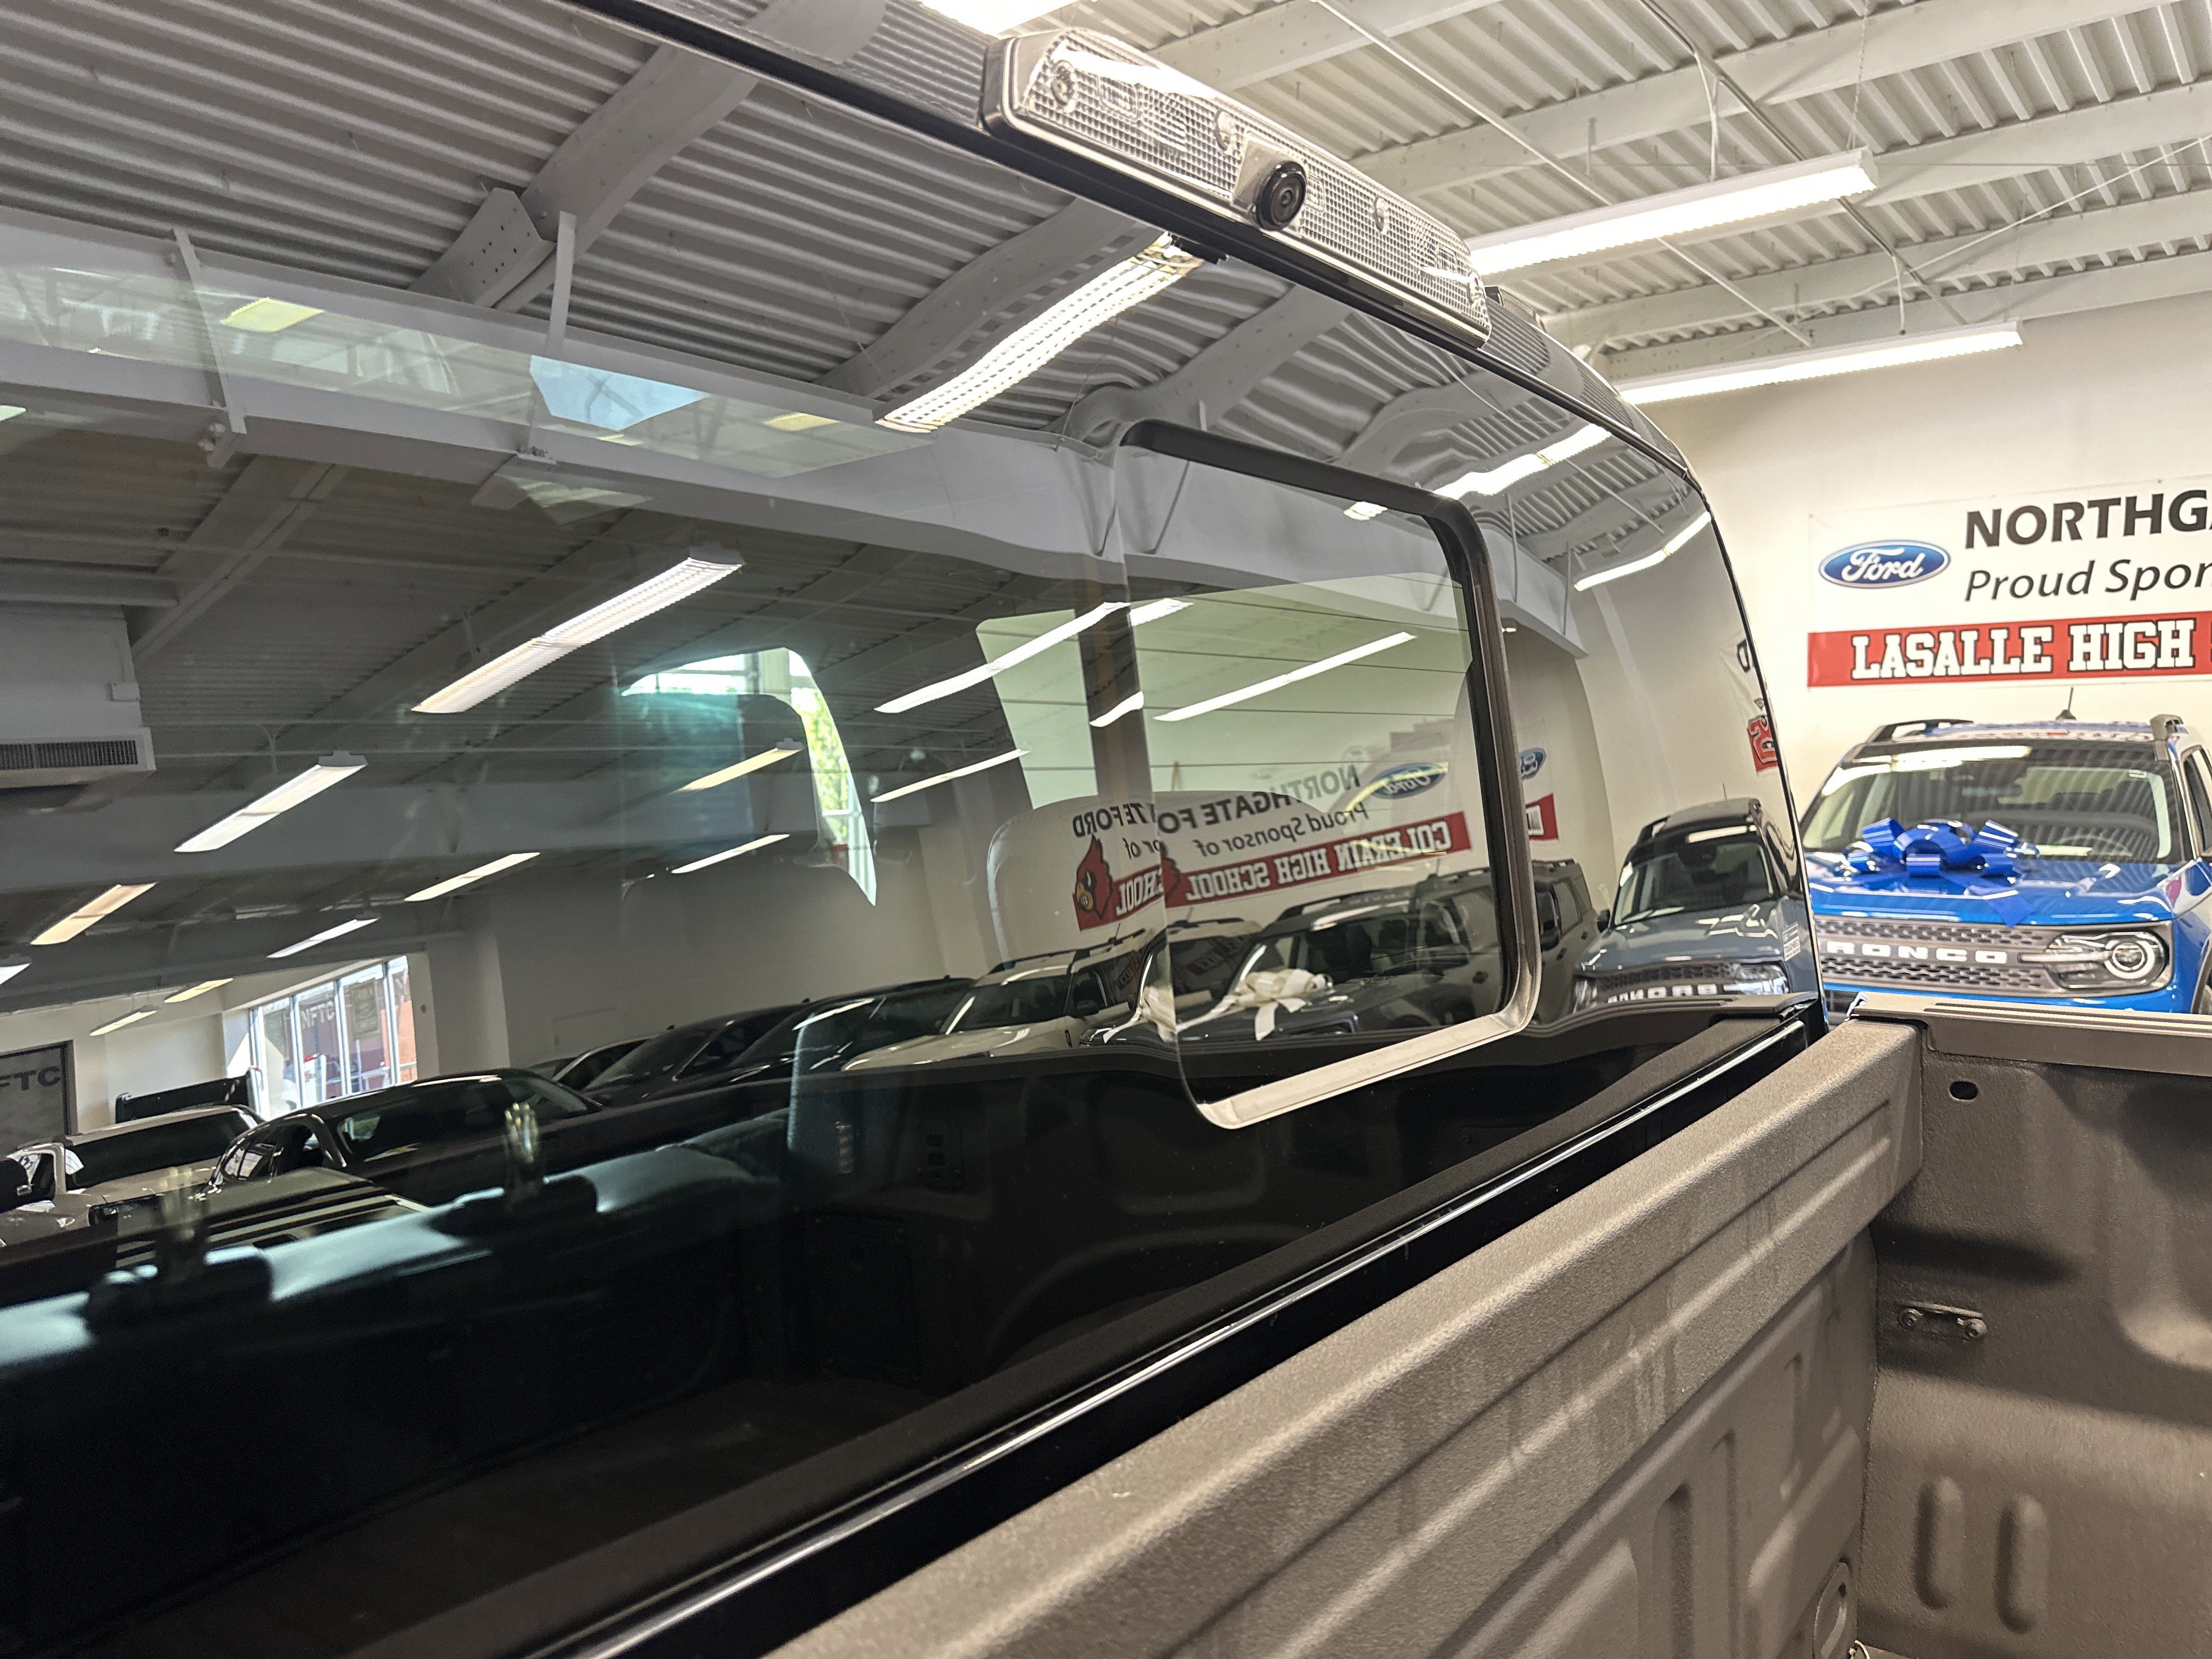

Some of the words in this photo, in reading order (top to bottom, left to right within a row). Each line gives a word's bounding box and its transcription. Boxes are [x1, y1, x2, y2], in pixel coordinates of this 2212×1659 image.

[1965, 488, 2212, 549] NORTHG
[1841, 548, 1927, 582] Ford
[1965, 558, 2096, 602] Proud
[1850, 624, 2053, 680] LASALLE
[2068, 618, 2197, 673] HIGH
[1818, 940, 2008, 964] RONCO
